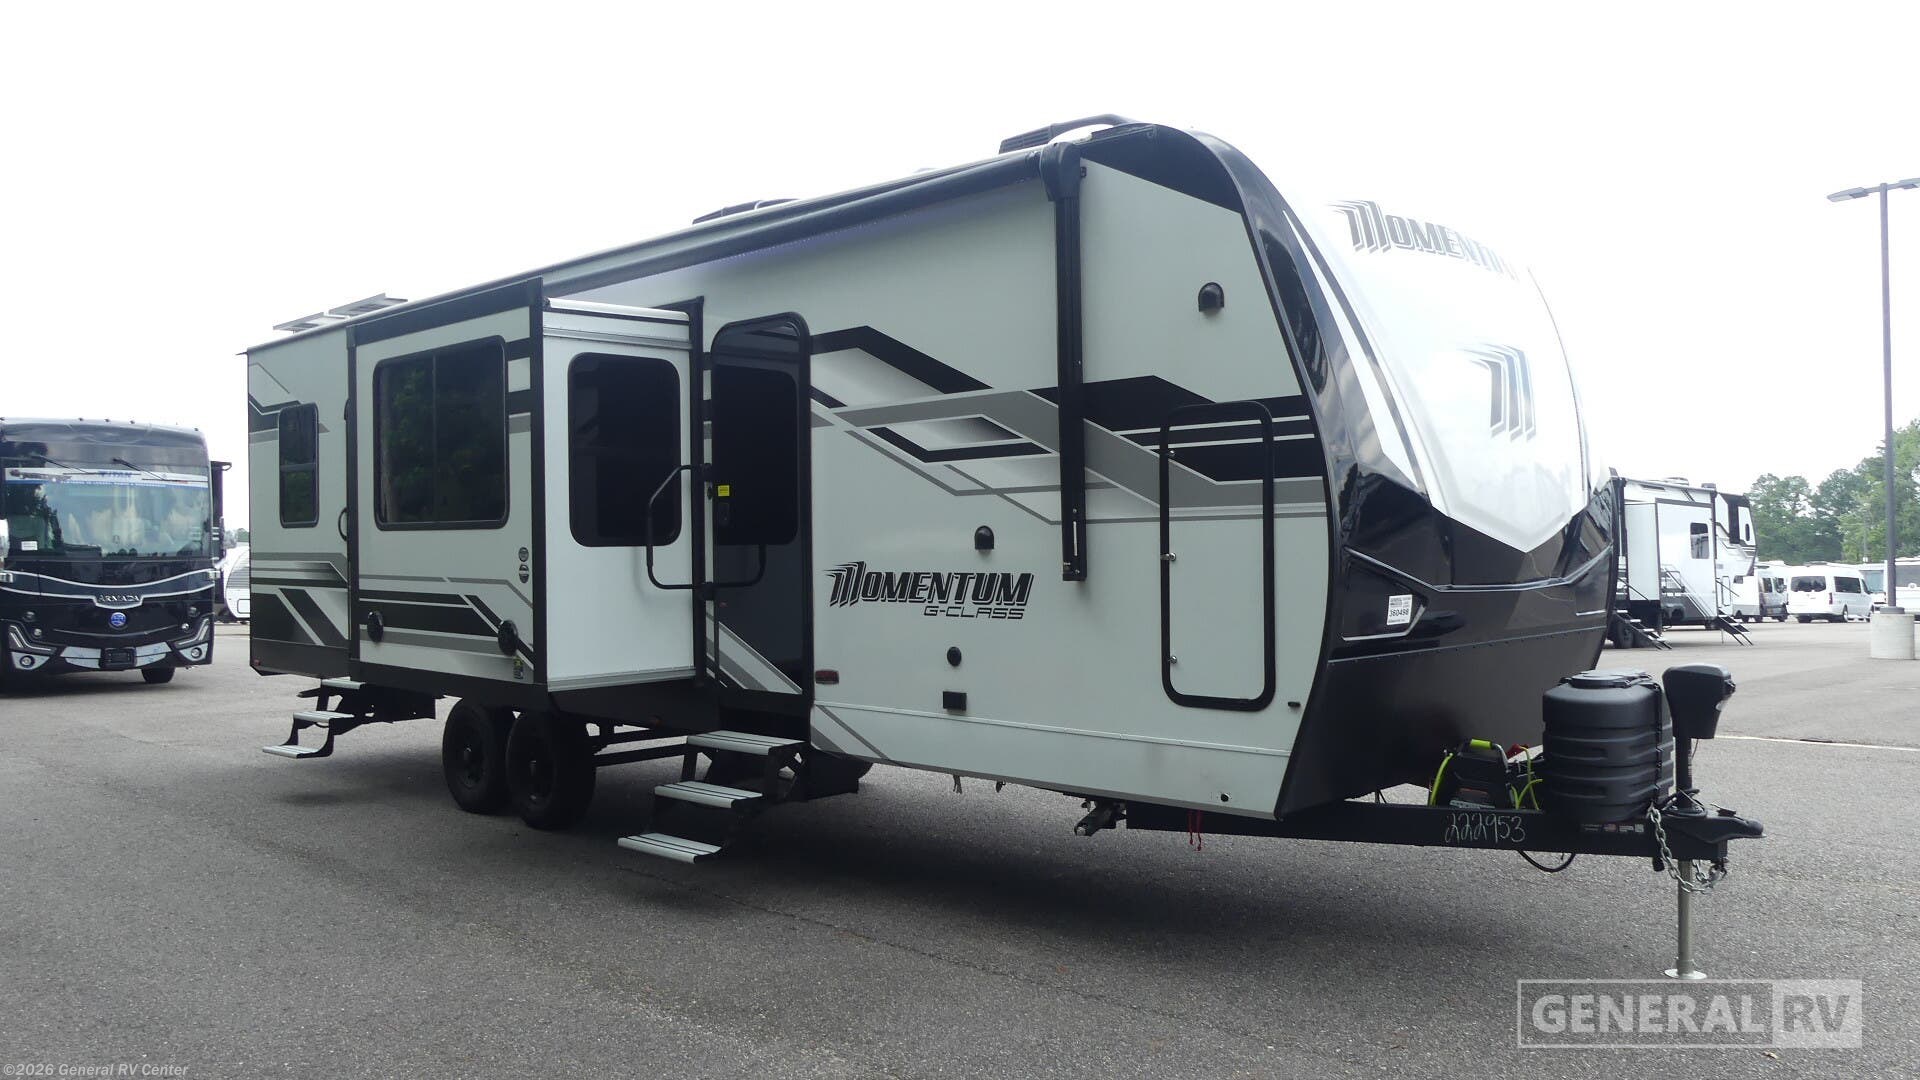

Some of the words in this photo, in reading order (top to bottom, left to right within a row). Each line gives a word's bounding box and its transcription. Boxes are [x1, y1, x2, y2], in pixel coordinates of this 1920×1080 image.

[823, 561, 1035, 607] MOMENTUM
[923, 605, 1025, 620] G-CLASS
[1444, 813, 1526, 844] 222953
